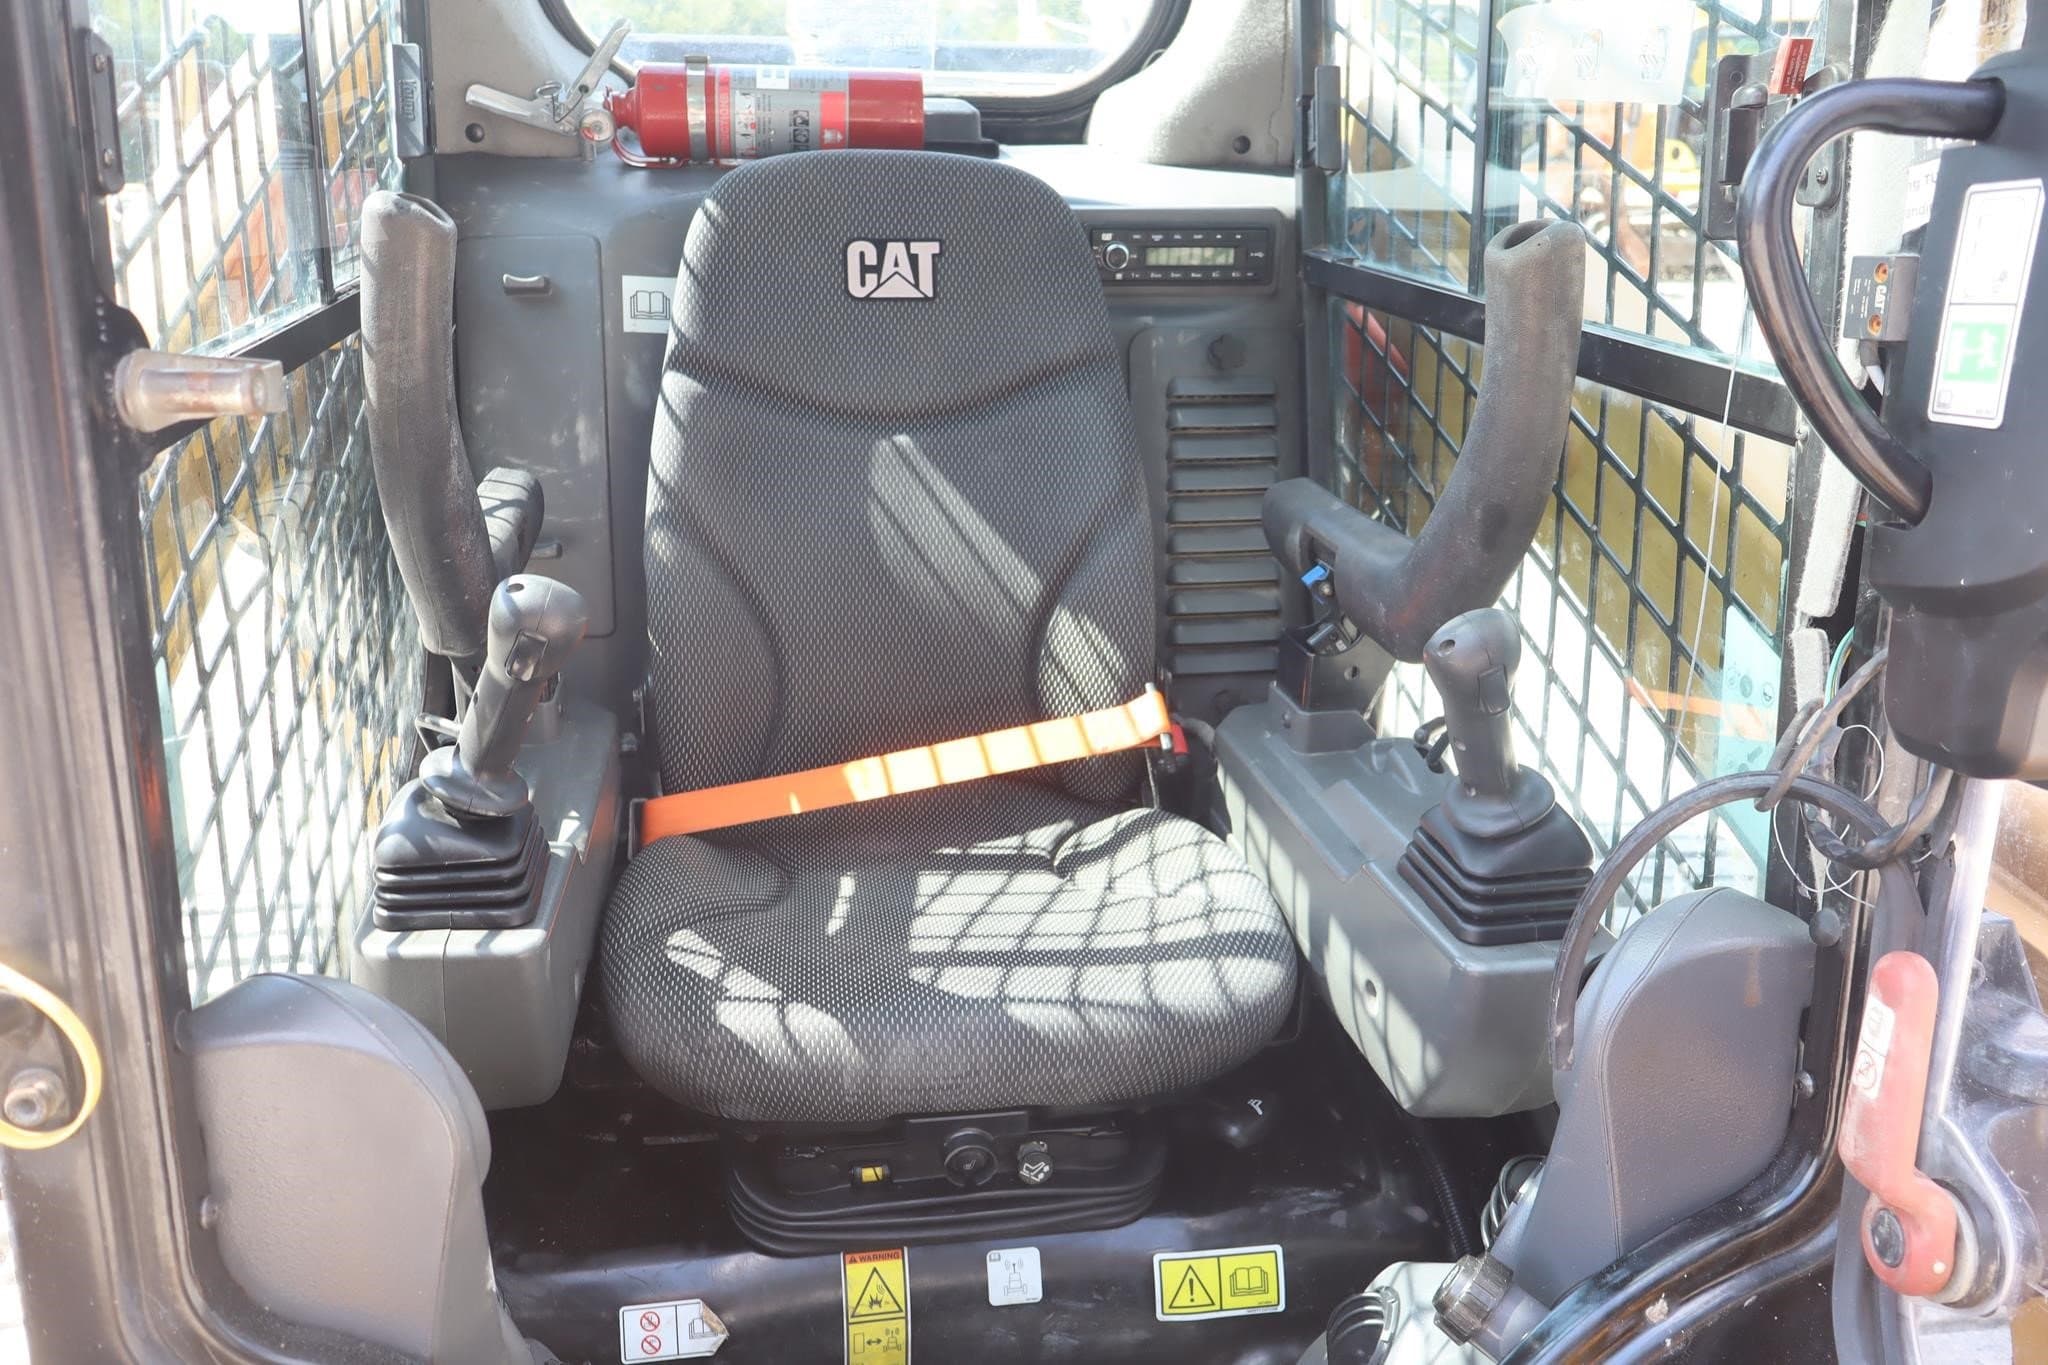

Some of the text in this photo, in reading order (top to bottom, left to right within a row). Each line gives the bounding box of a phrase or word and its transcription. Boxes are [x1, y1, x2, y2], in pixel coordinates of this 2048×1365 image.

[847, 240, 940, 298] CAT
[1874, 285, 1888, 309] CAT
[859, 1250, 900, 1263] WARNING
